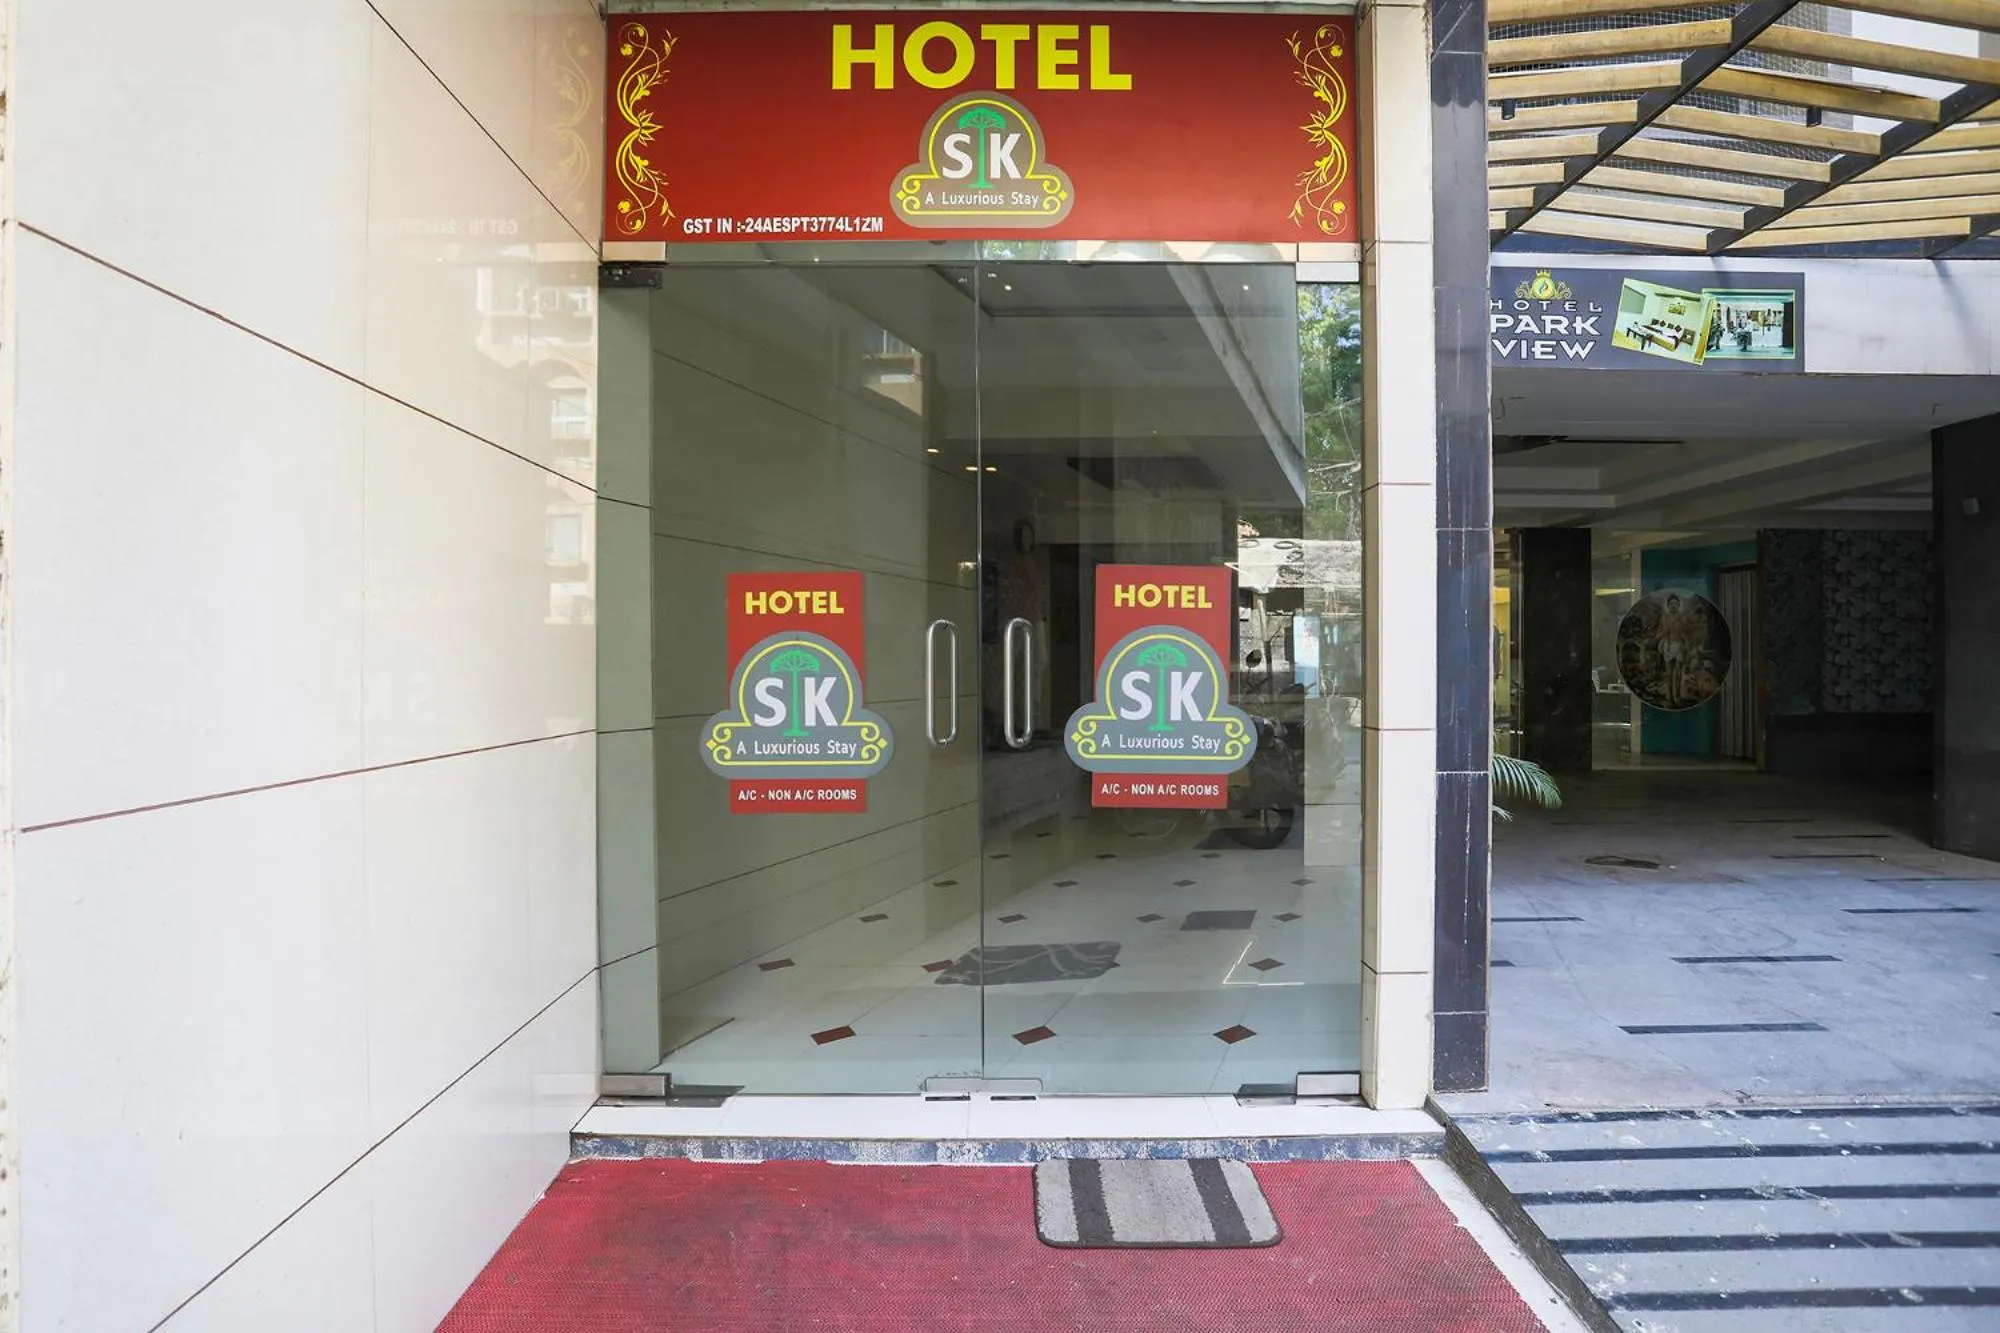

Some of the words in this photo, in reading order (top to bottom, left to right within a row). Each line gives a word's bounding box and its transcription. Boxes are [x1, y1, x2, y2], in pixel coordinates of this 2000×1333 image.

[832, 21, 1132, 91] HOTEL
[925, 191, 935, 205] A
[942, 190, 1004, 205] Luxurious
[1011, 190, 1040, 208] Stay
[683, 218, 712, 234] GST
[717, 218, 733, 234] IN
[1490, 299, 1602, 313] HOTEL
[1490, 314, 1601, 335] PARK
[1491, 339, 1597, 360] VIEW
[745, 590, 844, 615] HOTEL
[1113, 584, 1213, 609] HOTEL
[736, 740, 747, 755] A
[754, 739, 820, 755] Luxurious
[827, 739, 857, 758] Stay
[1101, 733, 1111, 748] A
[1119, 733, 1184, 749] Luxurious
[1191, 735, 1220, 753] Stay
[738, 789, 757, 801] A/C
[768, 789, 792, 801] NON
[795, 789, 814, 801] A/C
[817, 789, 857, 801] ROOMS
[1101, 783, 1120, 795] A/C
[1131, 783, 1154, 795] NON
[1158, 784, 1177, 796] A/C
[1180, 784, 1220, 796] ROOMS
